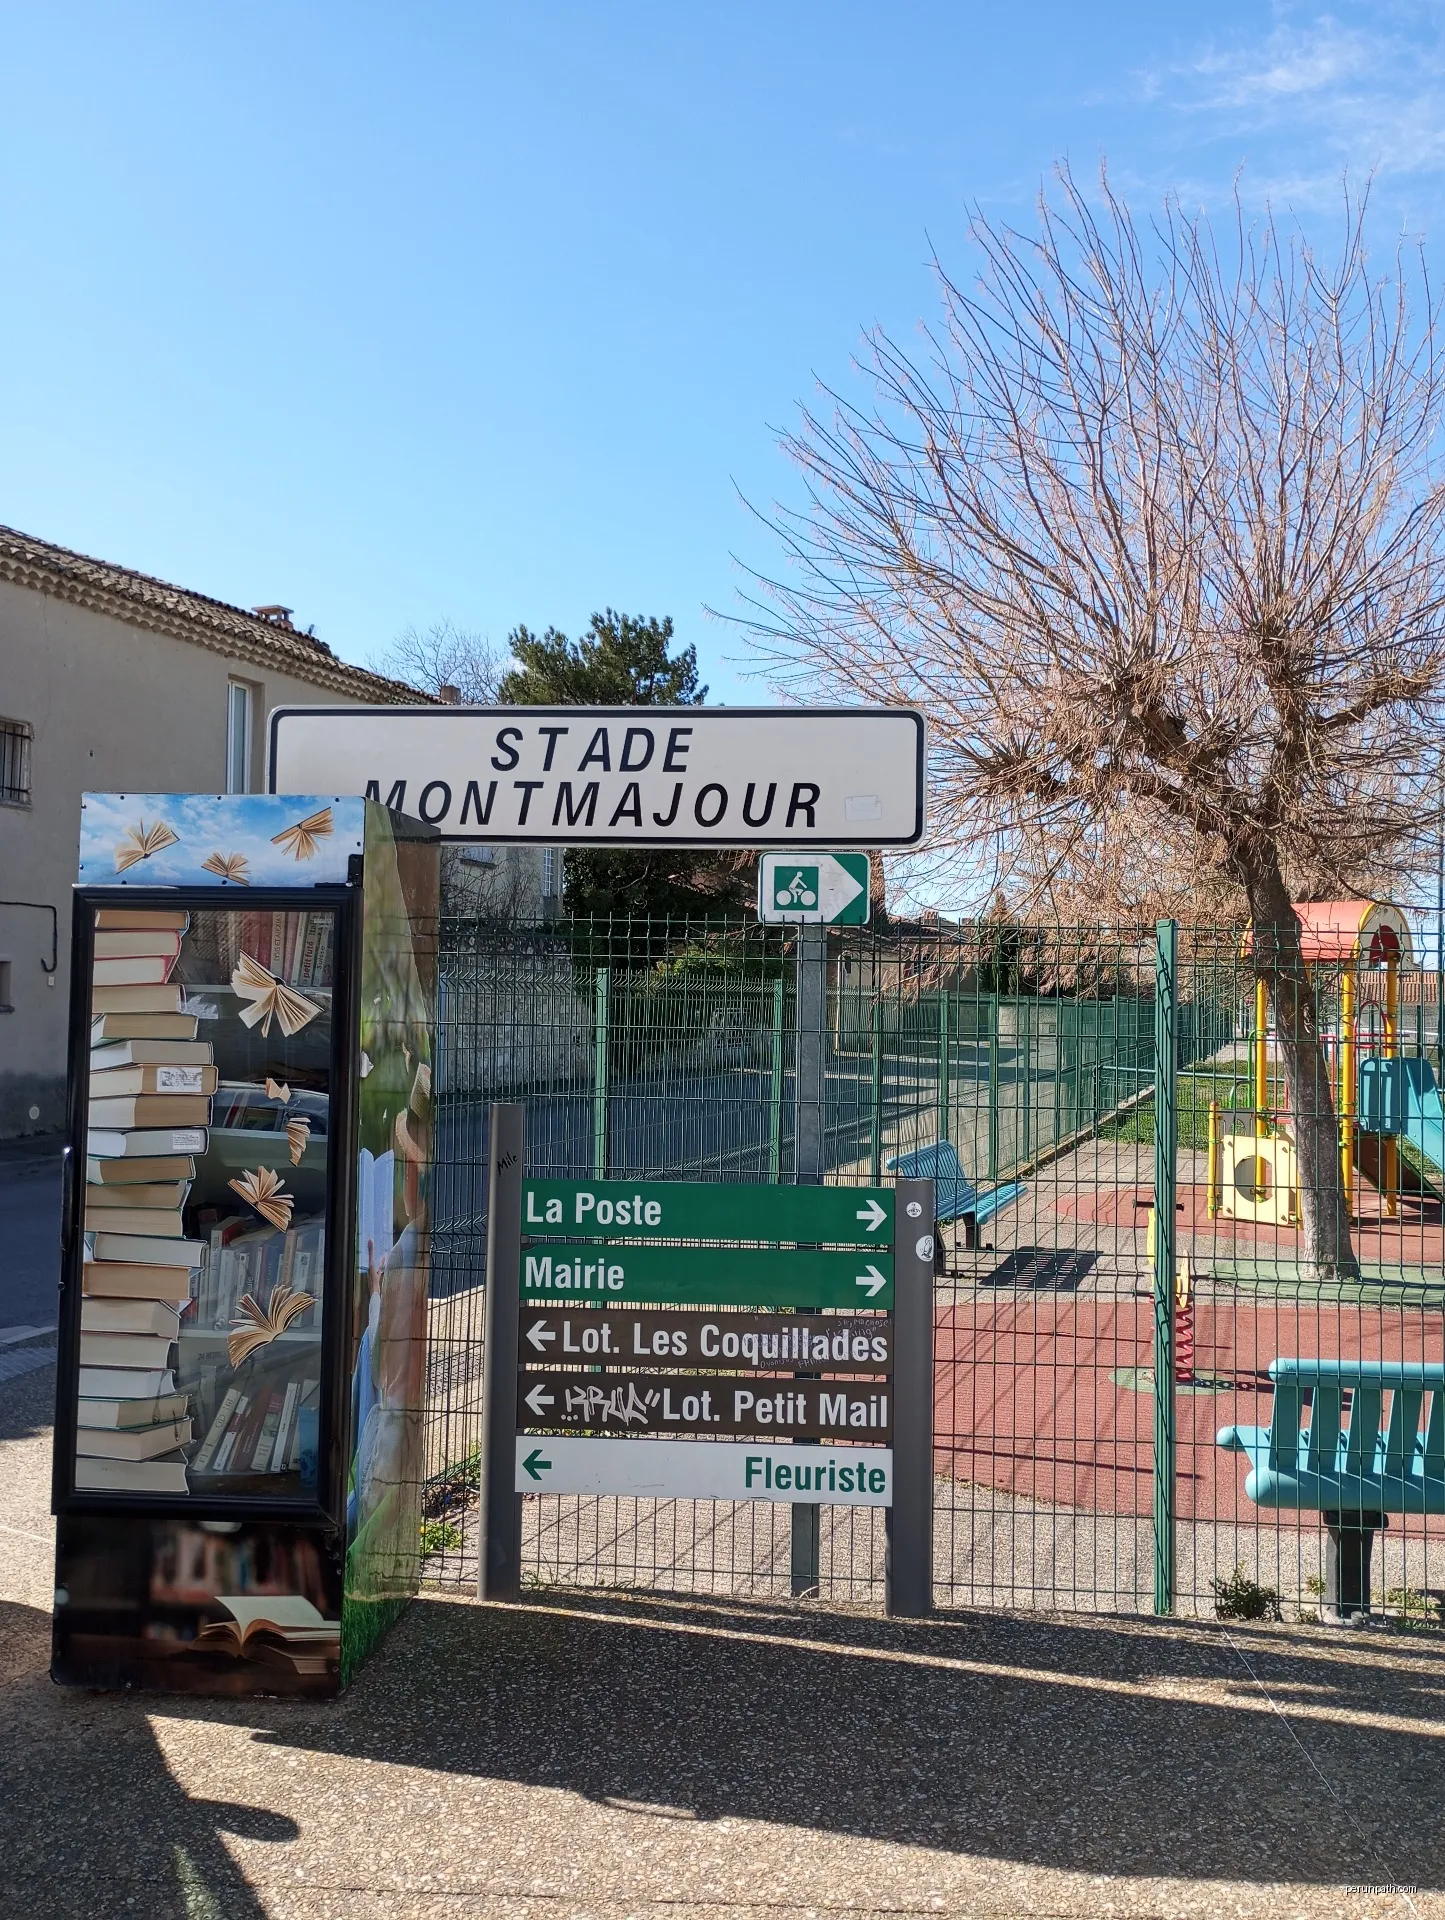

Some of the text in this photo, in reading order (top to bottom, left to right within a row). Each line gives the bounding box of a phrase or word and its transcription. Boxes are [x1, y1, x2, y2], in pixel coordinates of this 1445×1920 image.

[490, 726, 693, 773] STADE
[365, 779, 820, 828] MONTMAJOUR
[303, 959, 311, 978] petit
[526, 1191, 662, 1227] La Poste
[525, 1256, 625, 1291] Mairie
[563, 1321, 620, 1354] Lot.
[633, 1323, 688, 1357] Les
[700, 1324, 888, 1366] Coquillades
[663, 1388, 888, 1428] Lot. Petit Mail
[745, 1456, 887, 1493] Fleuriste
